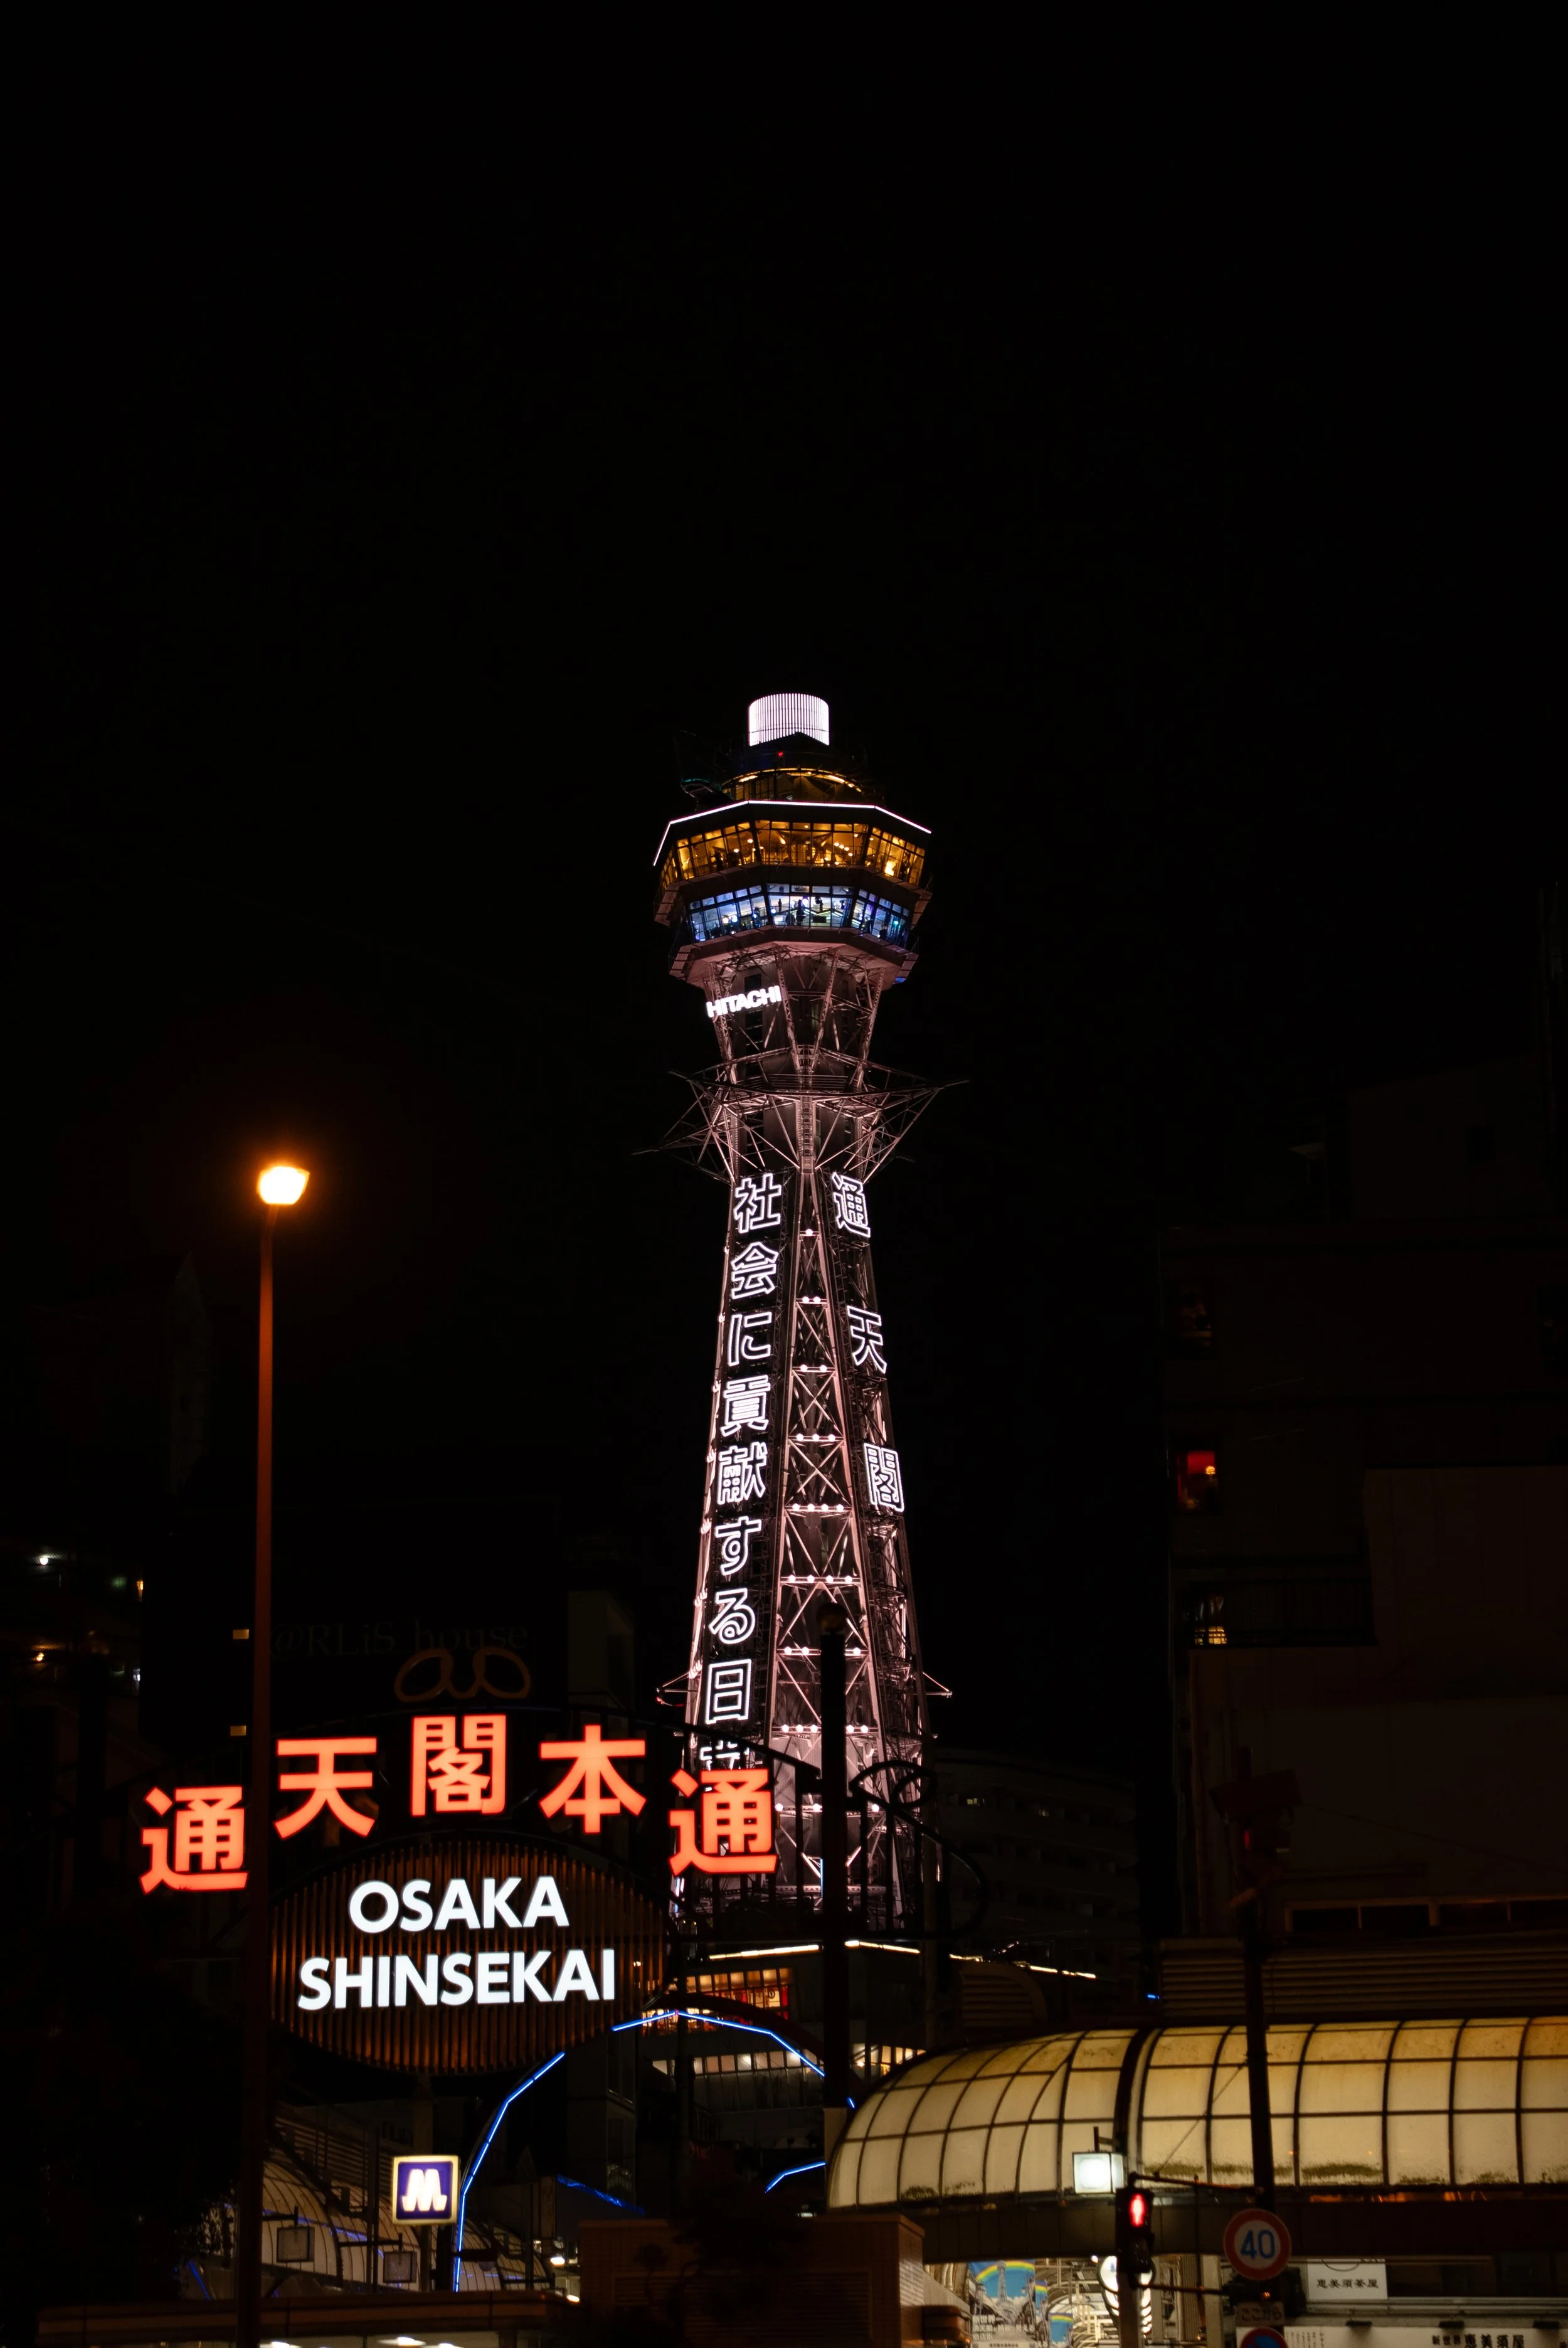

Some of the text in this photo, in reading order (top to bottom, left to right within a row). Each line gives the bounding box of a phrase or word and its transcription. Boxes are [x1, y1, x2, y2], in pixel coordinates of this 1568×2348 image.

[706, 985, 782, 1018] HITACHI
[832, 1172, 905, 1512] 通天閣
[139, 1713, 778, 1895] 通天閣本通
[348, 1875, 570, 1933] OSAKA
[297, 1948, 615, 2011] SHINSEKAI
[1241, 2229, 1275, 2259] 40
